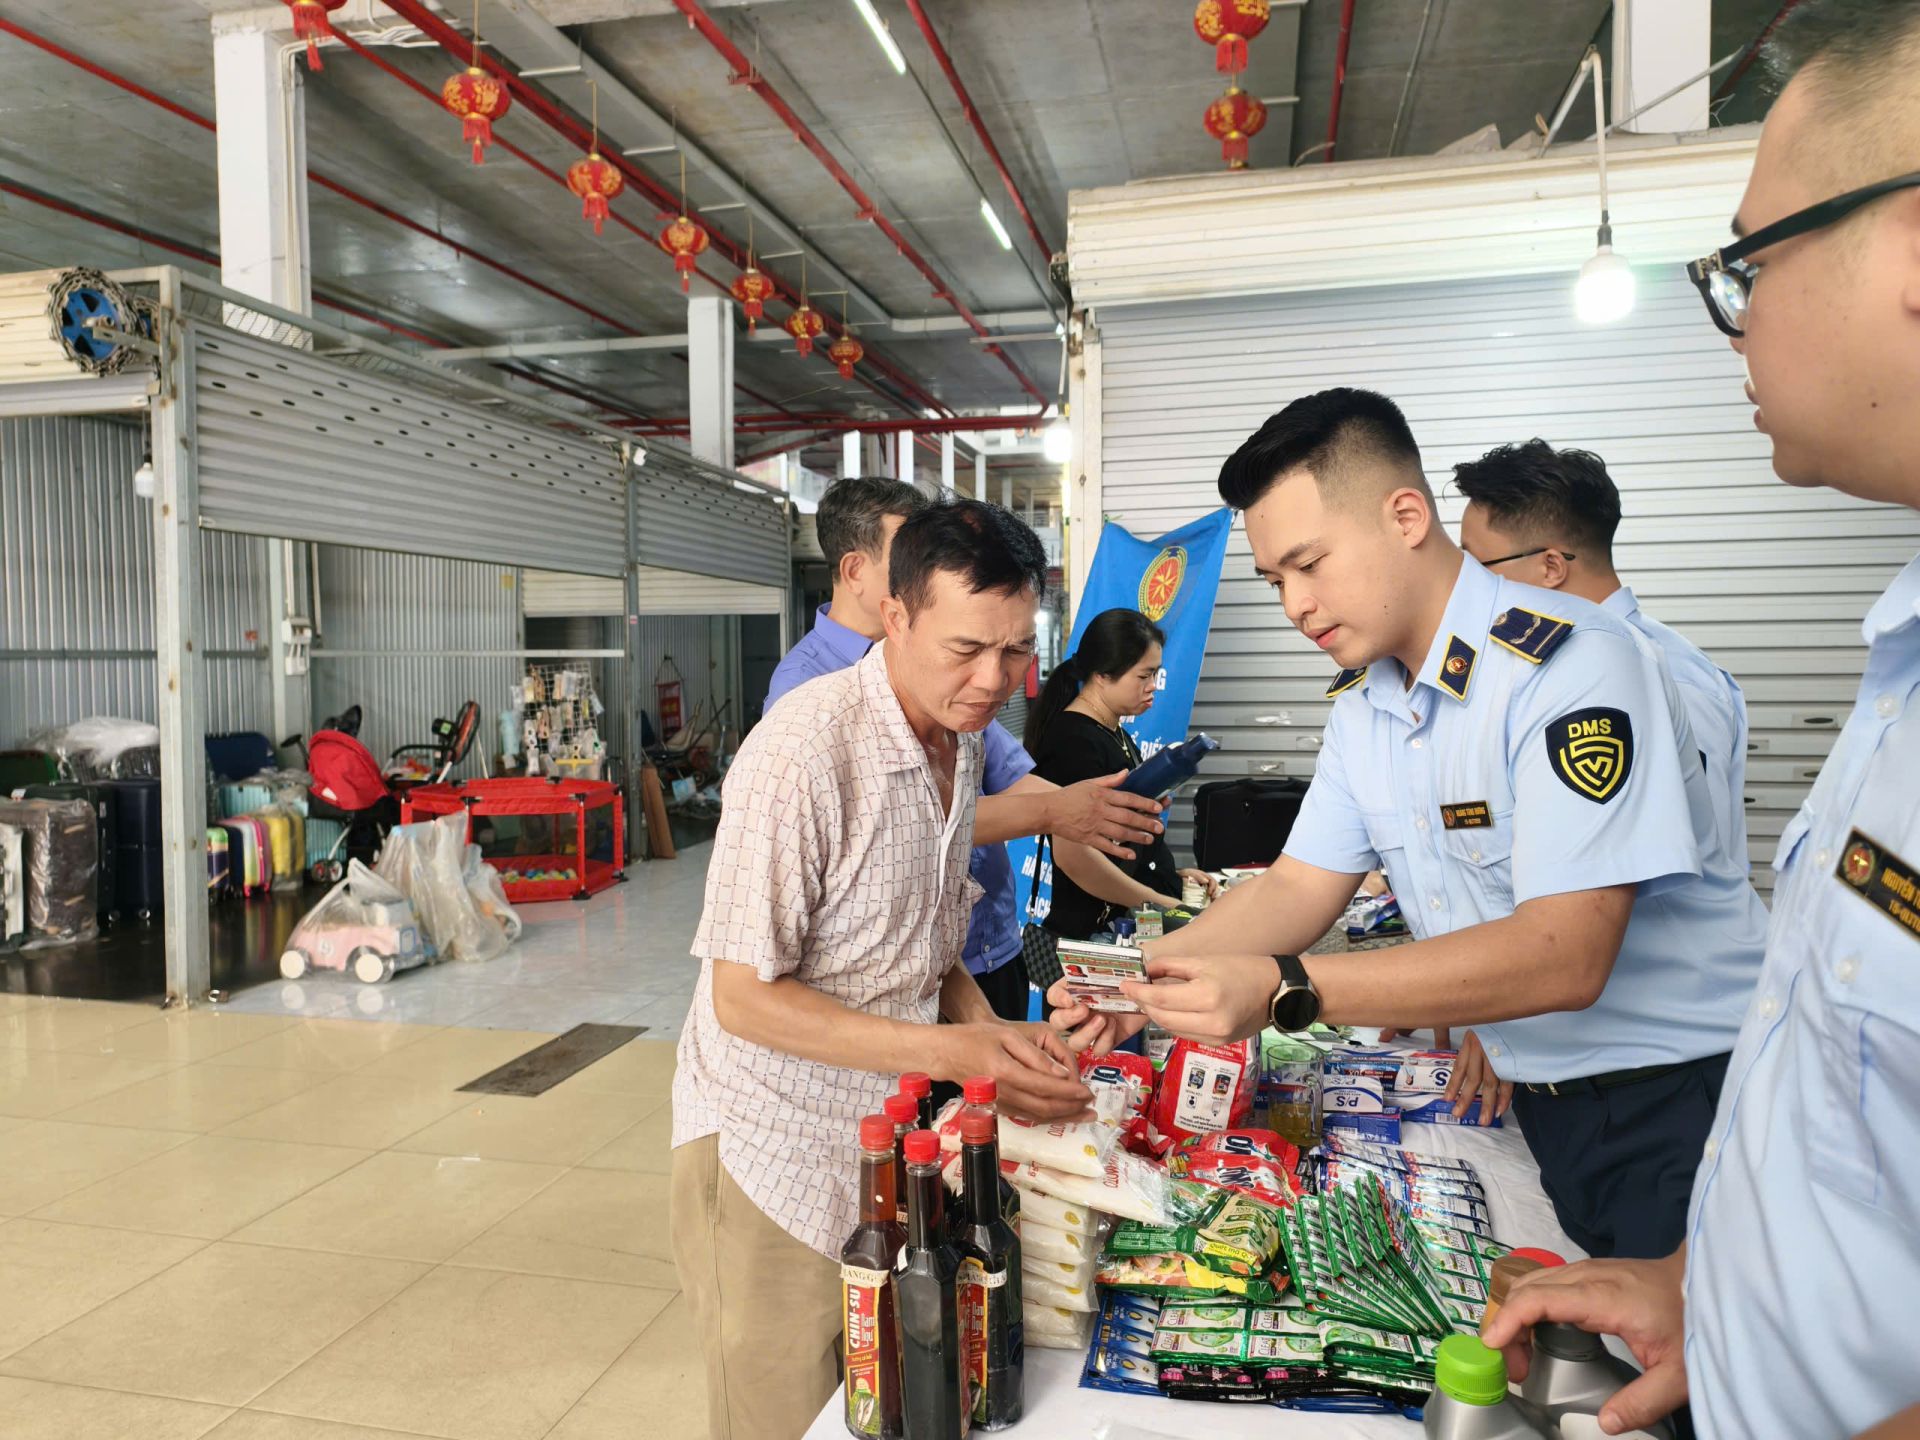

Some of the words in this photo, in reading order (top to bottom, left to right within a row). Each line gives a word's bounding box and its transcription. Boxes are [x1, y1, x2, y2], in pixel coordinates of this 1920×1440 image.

[1568, 718, 1612, 739] DMS
[1336, 1096, 1359, 1107] P/S
[849, 1289, 861, 1349] CHIN-SU
